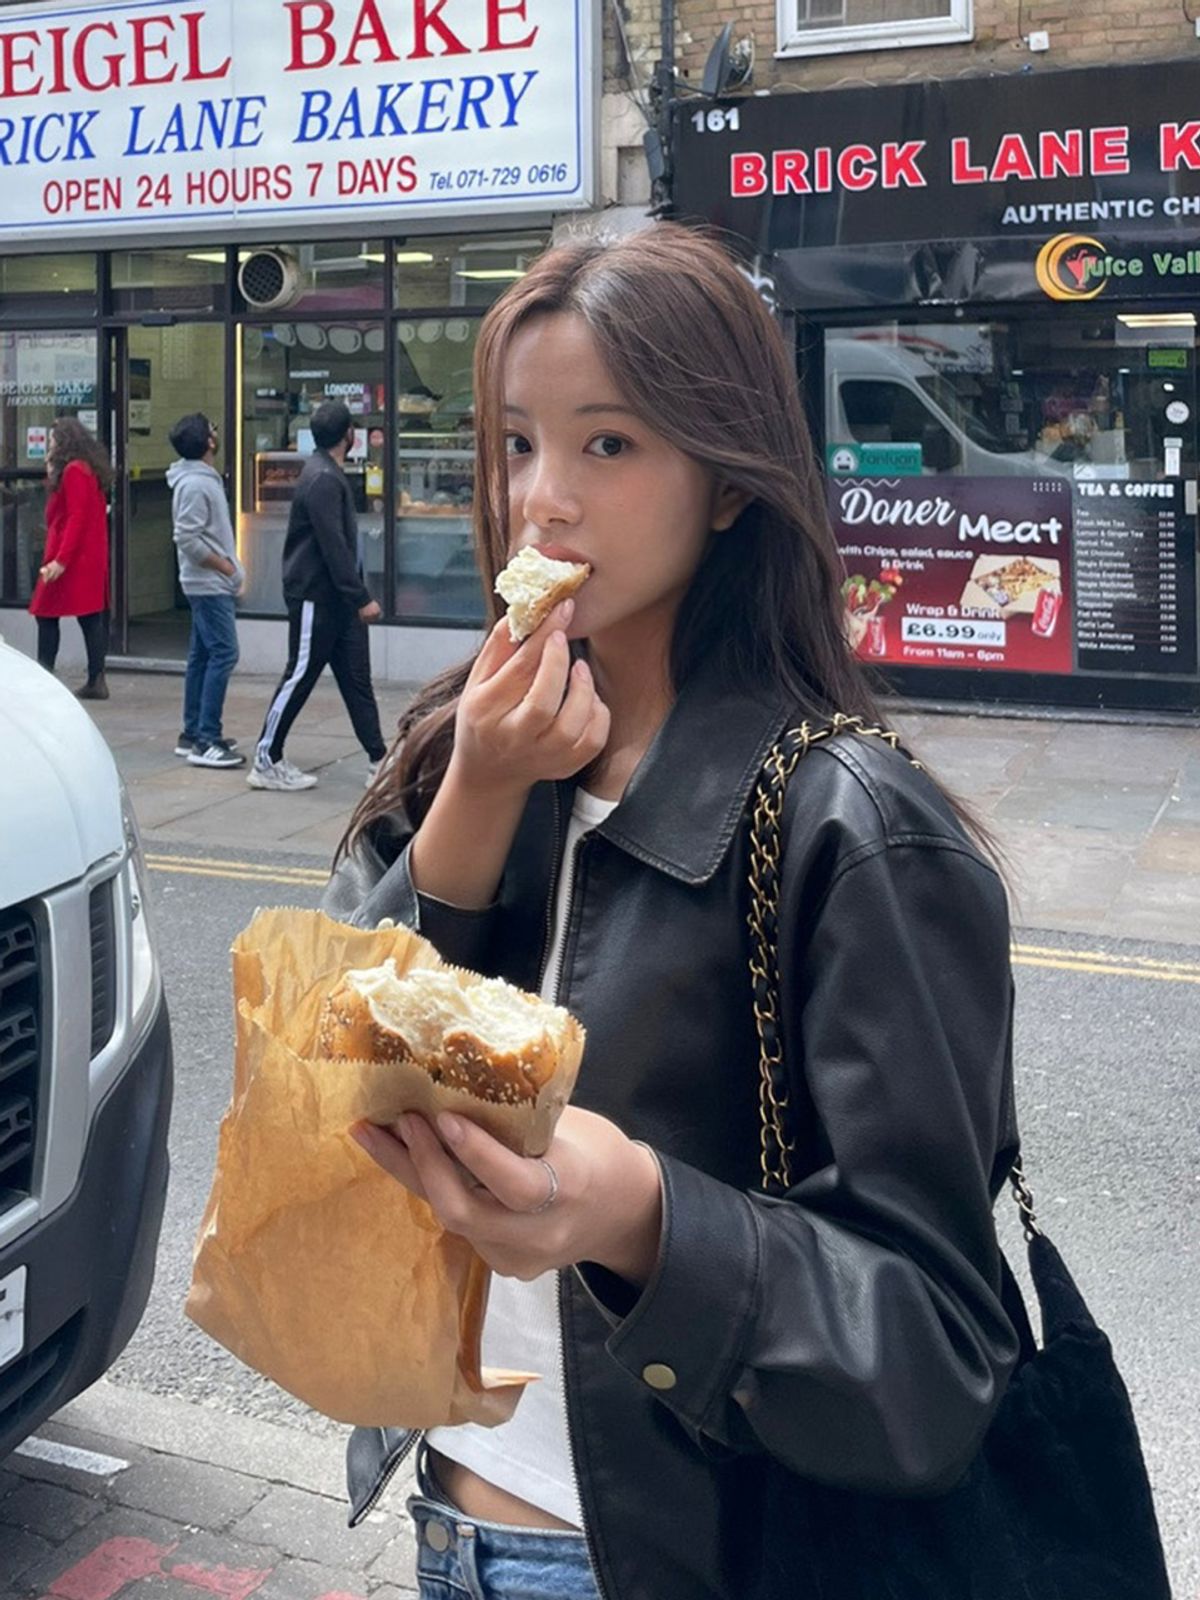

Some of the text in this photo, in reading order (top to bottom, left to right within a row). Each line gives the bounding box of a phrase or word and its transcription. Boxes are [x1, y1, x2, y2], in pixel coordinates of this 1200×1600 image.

[283, 0, 540, 72] BAKE
[122, 96, 267, 157] LANE
[292, 70, 539, 144] BAKERY
[691, 107, 740, 132] 161
[527, 162, 568, 184] 0616
[729, 140, 927, 198] BRICK
[951, 126, 1130, 184] LANE
[43, 155, 418, 215] OPEN 24 HOURS 7 DAYS
[1001, 199, 1155, 226] AUTHENTIC
[324, 383, 364, 396] LONDON
[1077, 483, 1174, 498] TEA & COFFEE
[840, 487, 956, 526] Doner
[958, 514, 1063, 545] Meat
[906, 603, 944, 617] Wrap
[907, 622, 976, 640] £6.99
[903, 645, 934, 657] From
